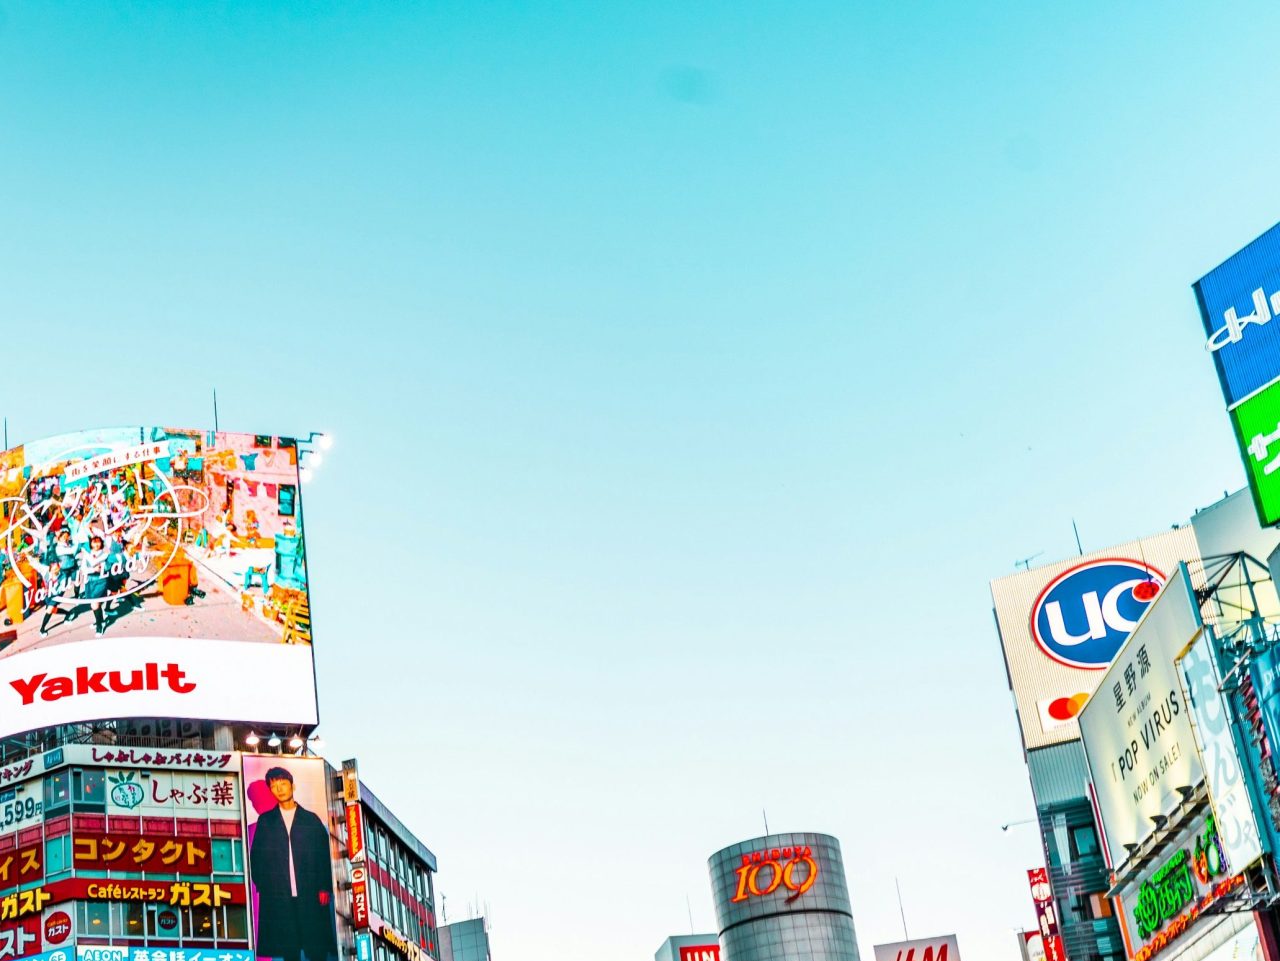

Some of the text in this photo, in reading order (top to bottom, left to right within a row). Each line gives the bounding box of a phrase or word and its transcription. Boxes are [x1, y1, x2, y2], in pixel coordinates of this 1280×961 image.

[10, 663, 197, 706] Yakult
[1113, 645, 1151, 713] 星野源
[91, 747, 232, 768] しゃぶしゃぶバイキング
[152, 780, 235, 806] しゃぶ葉
[1133, 779, 1149, 804] NOW
[1149, 769, 1160, 788] ON
[74, 838, 206, 864] コンタクト
[742, 847, 811, 866] SHIBUYA
[87, 881, 231, 906] Caféレストラン ガスト
[731, 856, 818, 905] 109
[1, 888, 51, 921] ガスト
